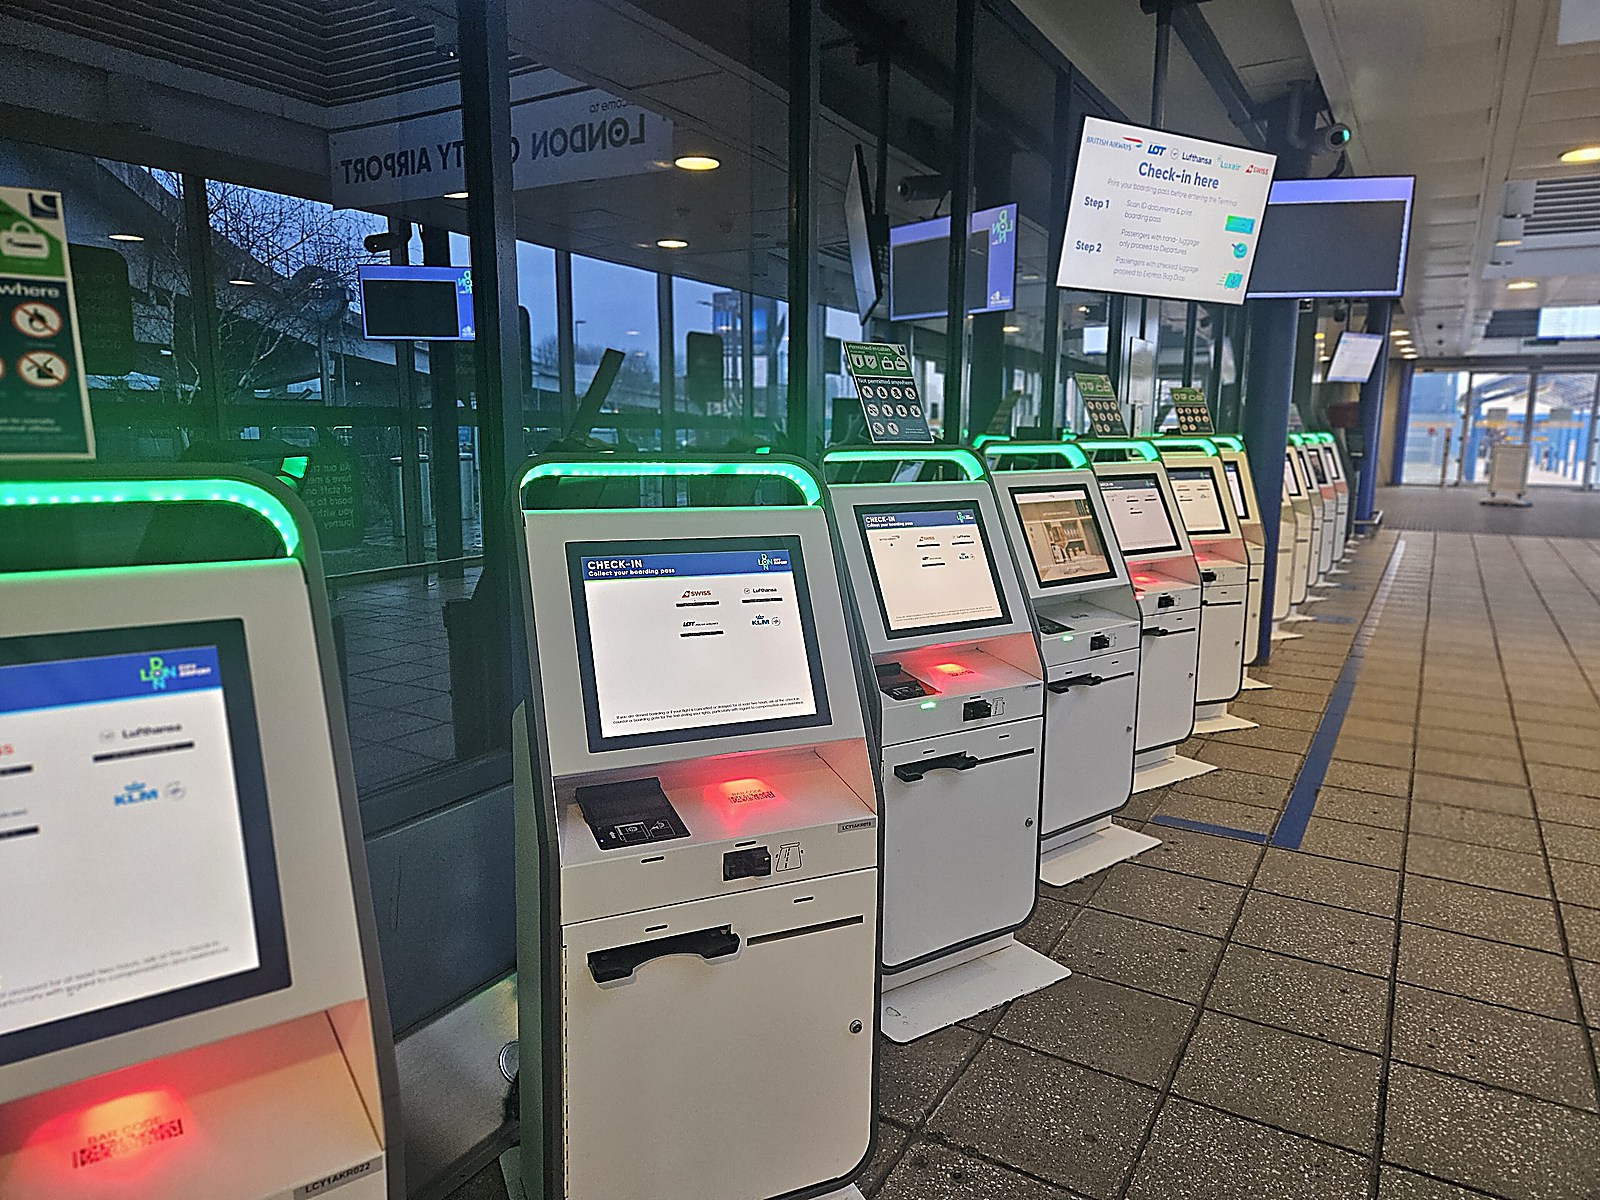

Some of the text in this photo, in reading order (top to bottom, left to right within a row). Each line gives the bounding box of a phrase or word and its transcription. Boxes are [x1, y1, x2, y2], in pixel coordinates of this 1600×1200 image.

[1086, 136, 1132, 151] BRITISH AIRWAYS
[1147, 144, 1167, 156] LOT
[1182, 152, 1212, 165] Lufthansa
[1220, 160, 1241, 170] Luxair
[1138, 162, 1220, 189] Check-in here
[1252, 166, 1270, 176] SWISS
[1107, 178, 1120, 187] Print
[1121, 182, 1132, 190] your
[1133, 182, 1156, 195] boarding
[1157, 188, 1170, 196] pass
[1171, 187, 1187, 198] before
[1188, 192, 1208, 203] entering
[1084, 196, 1110, 210] Step 1
[1126, 200, 1140, 208] Scan
[1147, 203, 1176, 214] documents
[1180, 209, 1192, 217] print
[1124, 212, 1148, 222] boarding
[1120, 229, 1150, 240] Passengers
[1180, 237, 1200, 247] luggage
[1076, 240, 1102, 253] Step 2
[1119, 240, 1130, 249] only
[1130, 242, 1152, 252] proceed
[1160, 244, 1187, 255] Departures
[1116, 256, 1145, 267] Passengers
[1157, 262, 1178, 270] checked
[1179, 264, 1199, 273] luggage
[1113, 267, 1135, 276] proceed
[1143, 270, 1162, 280] Express
[1162, 272, 1173, 281] Bag
[1173, 273, 1186, 281] Drop
[587, 559, 642, 570] CHECK-IN
[122, 724, 183, 740] Lufthansa
[114, 789, 159, 806] KLM
[305, 1162, 370, 1194] LCY1AKR022
